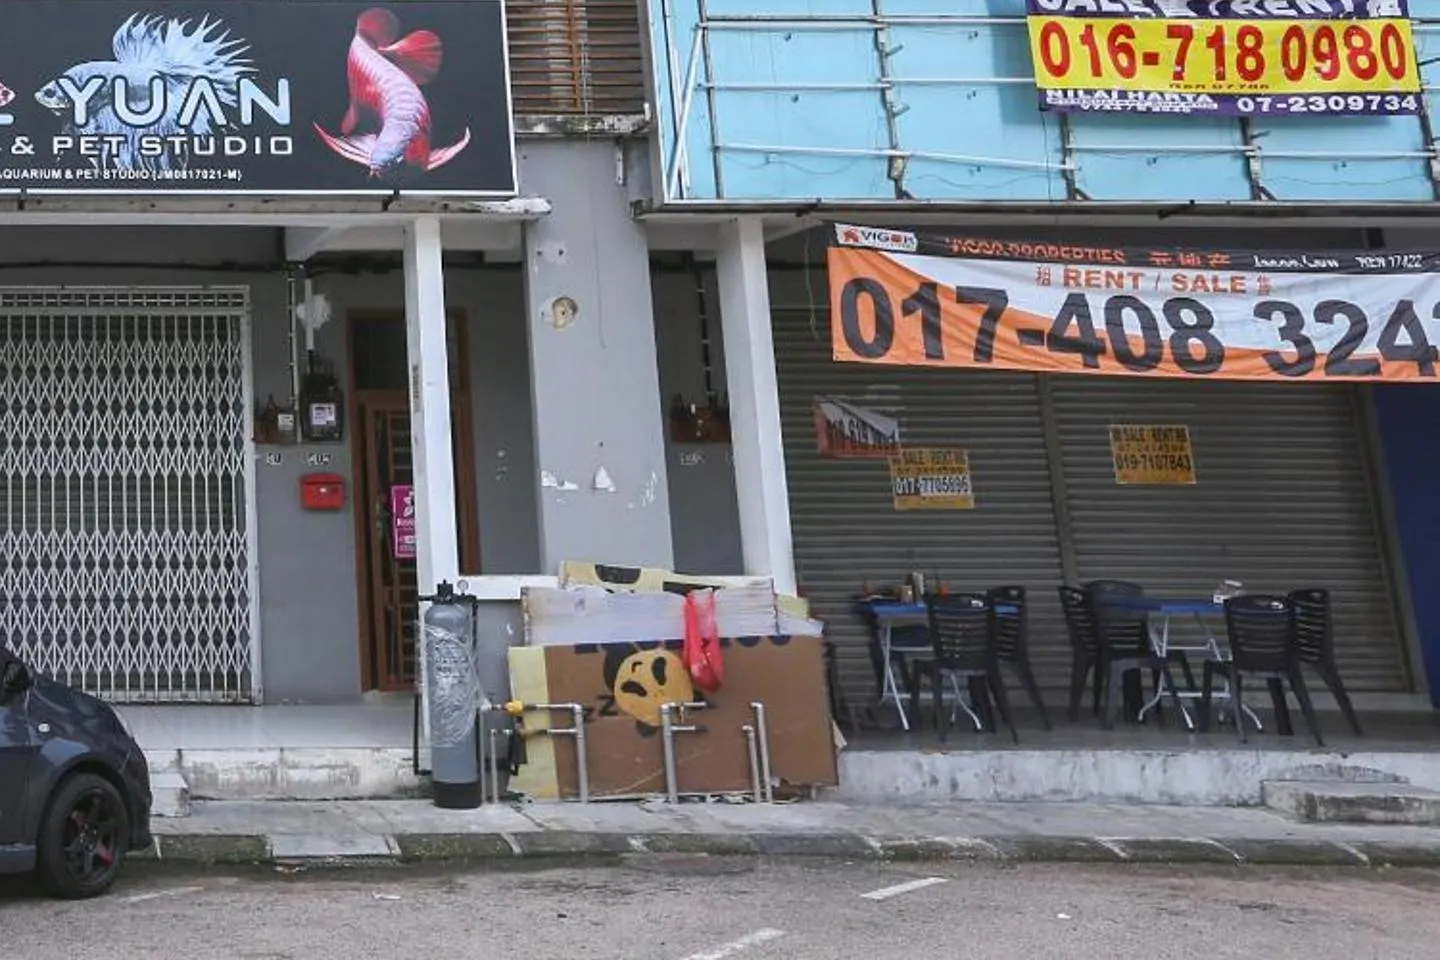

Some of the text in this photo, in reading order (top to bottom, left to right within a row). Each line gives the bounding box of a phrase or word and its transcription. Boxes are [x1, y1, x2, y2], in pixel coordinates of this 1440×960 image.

[1039, 20, 1408, 82] 016-718 0980
[58, 77, 290, 126] YUAN
[1237, 95, 1419, 113] 07-2309734
[10, 136, 35, 155] &
[52, 136, 126, 155] PET
[140, 136, 293, 156] STUDIO
[65, 169, 74, 179] &
[76, 170, 99, 179] PET
[103, 169, 149, 179] STUDIO
[1063, 267, 1144, 290] RENT
[1171, 273, 1246, 294] SALE
[840, 277, 1440, 378] 017-408 324
